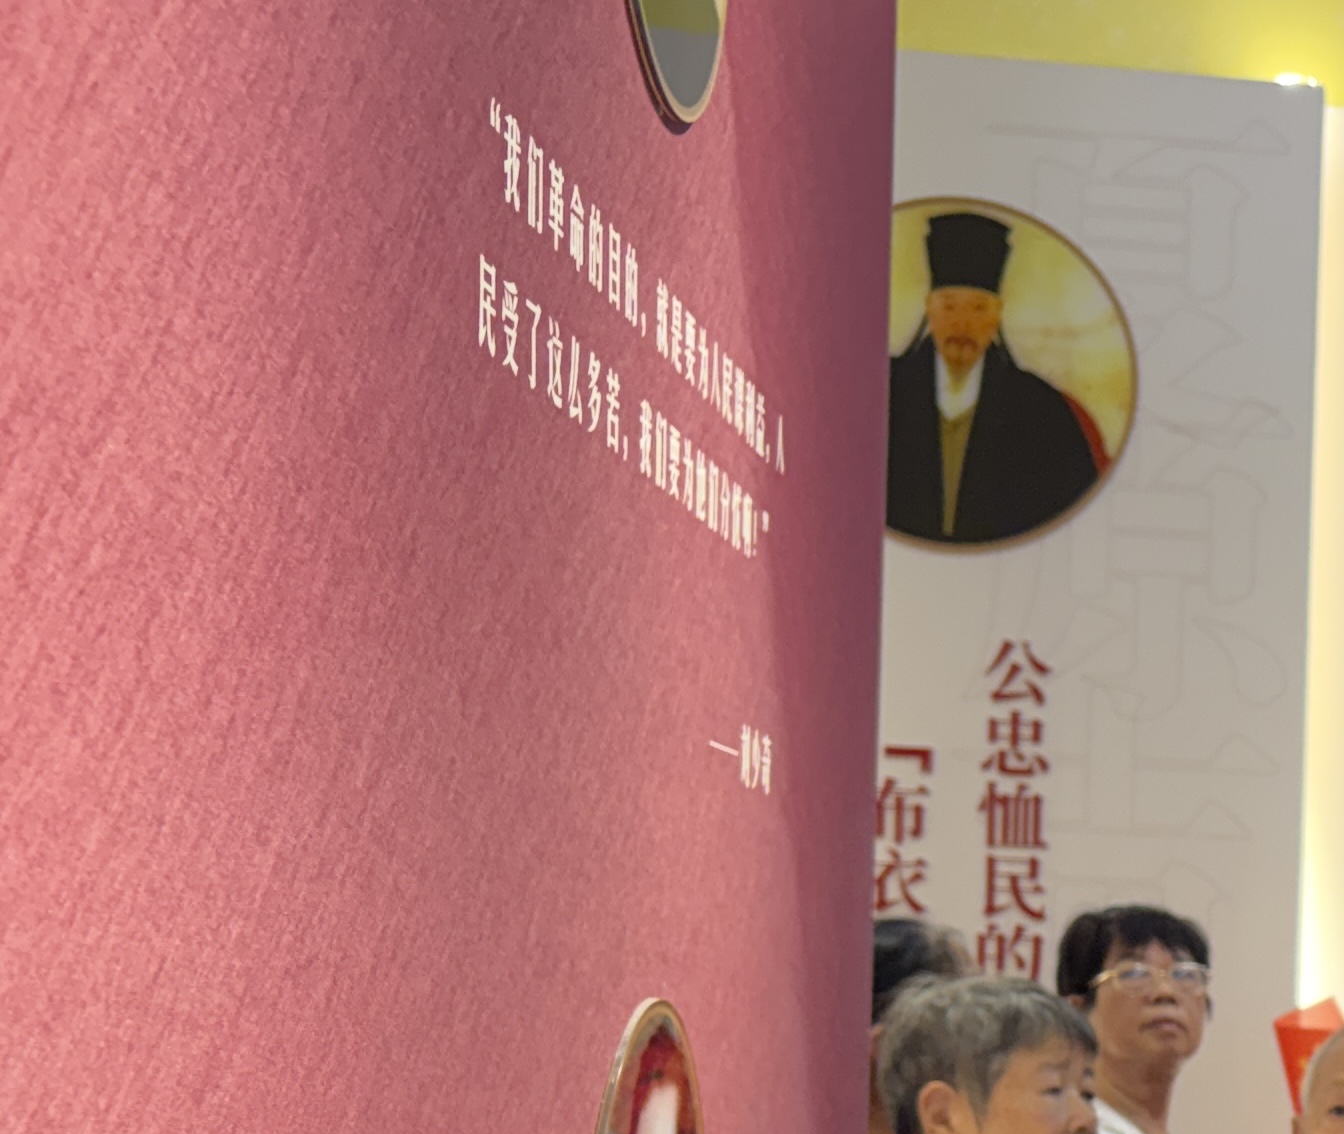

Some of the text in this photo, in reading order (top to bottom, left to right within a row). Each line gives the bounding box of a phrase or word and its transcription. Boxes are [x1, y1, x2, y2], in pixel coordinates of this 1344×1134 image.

[976, 638, 1053, 984] 公忠恤民的
